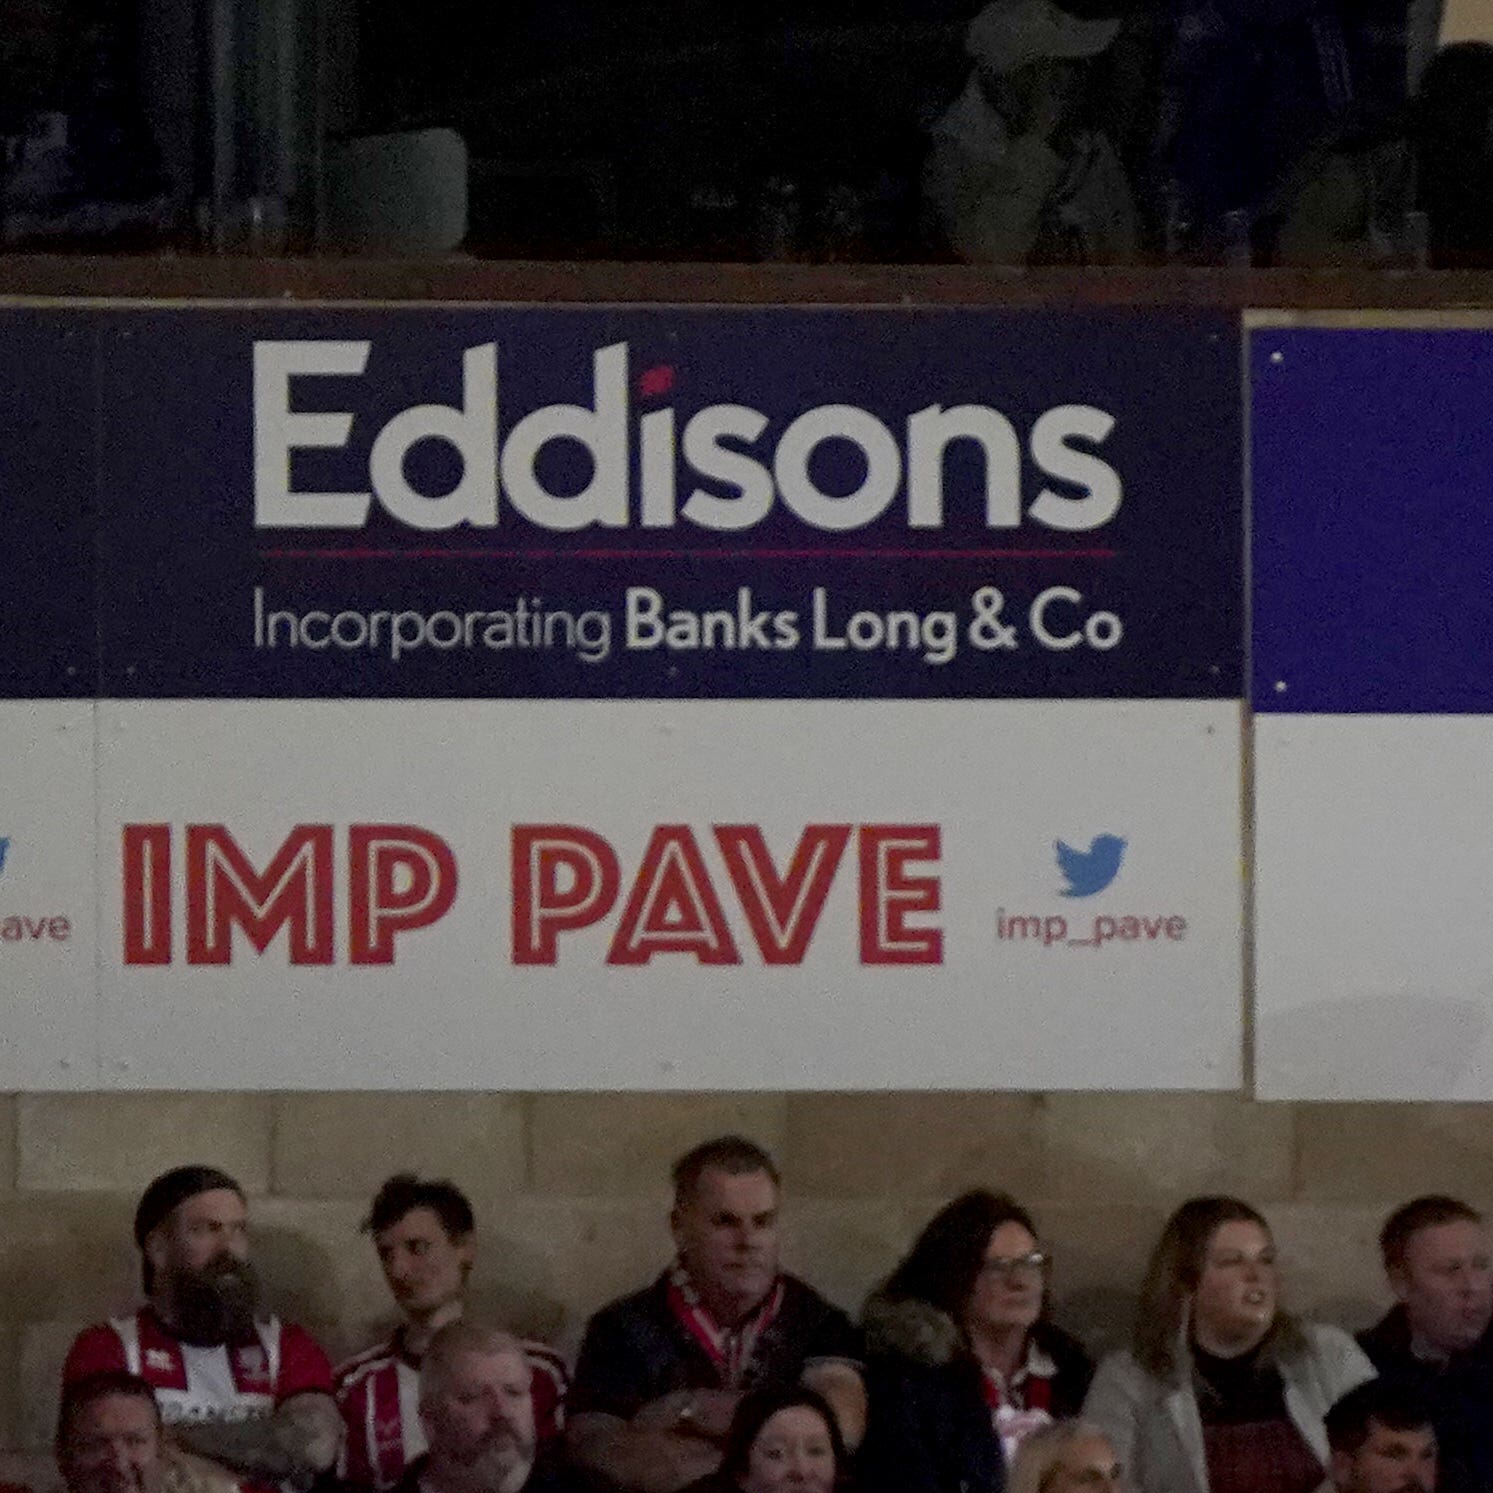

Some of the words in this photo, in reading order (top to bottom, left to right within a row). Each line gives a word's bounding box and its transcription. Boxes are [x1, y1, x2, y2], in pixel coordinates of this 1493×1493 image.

[254, 341, 1122, 531] Eddisons
[254, 587, 611, 663] Incorporating
[625, 587, 800, 650] Banks
[812, 587, 958, 665] Long
[968, 587, 1018, 650] &
[1029, 586, 1123, 651] Co
[122, 824, 458, 967] IMP
[510, 823, 944, 967] PAVE
[996, 906, 1187, 947] imp_pave
